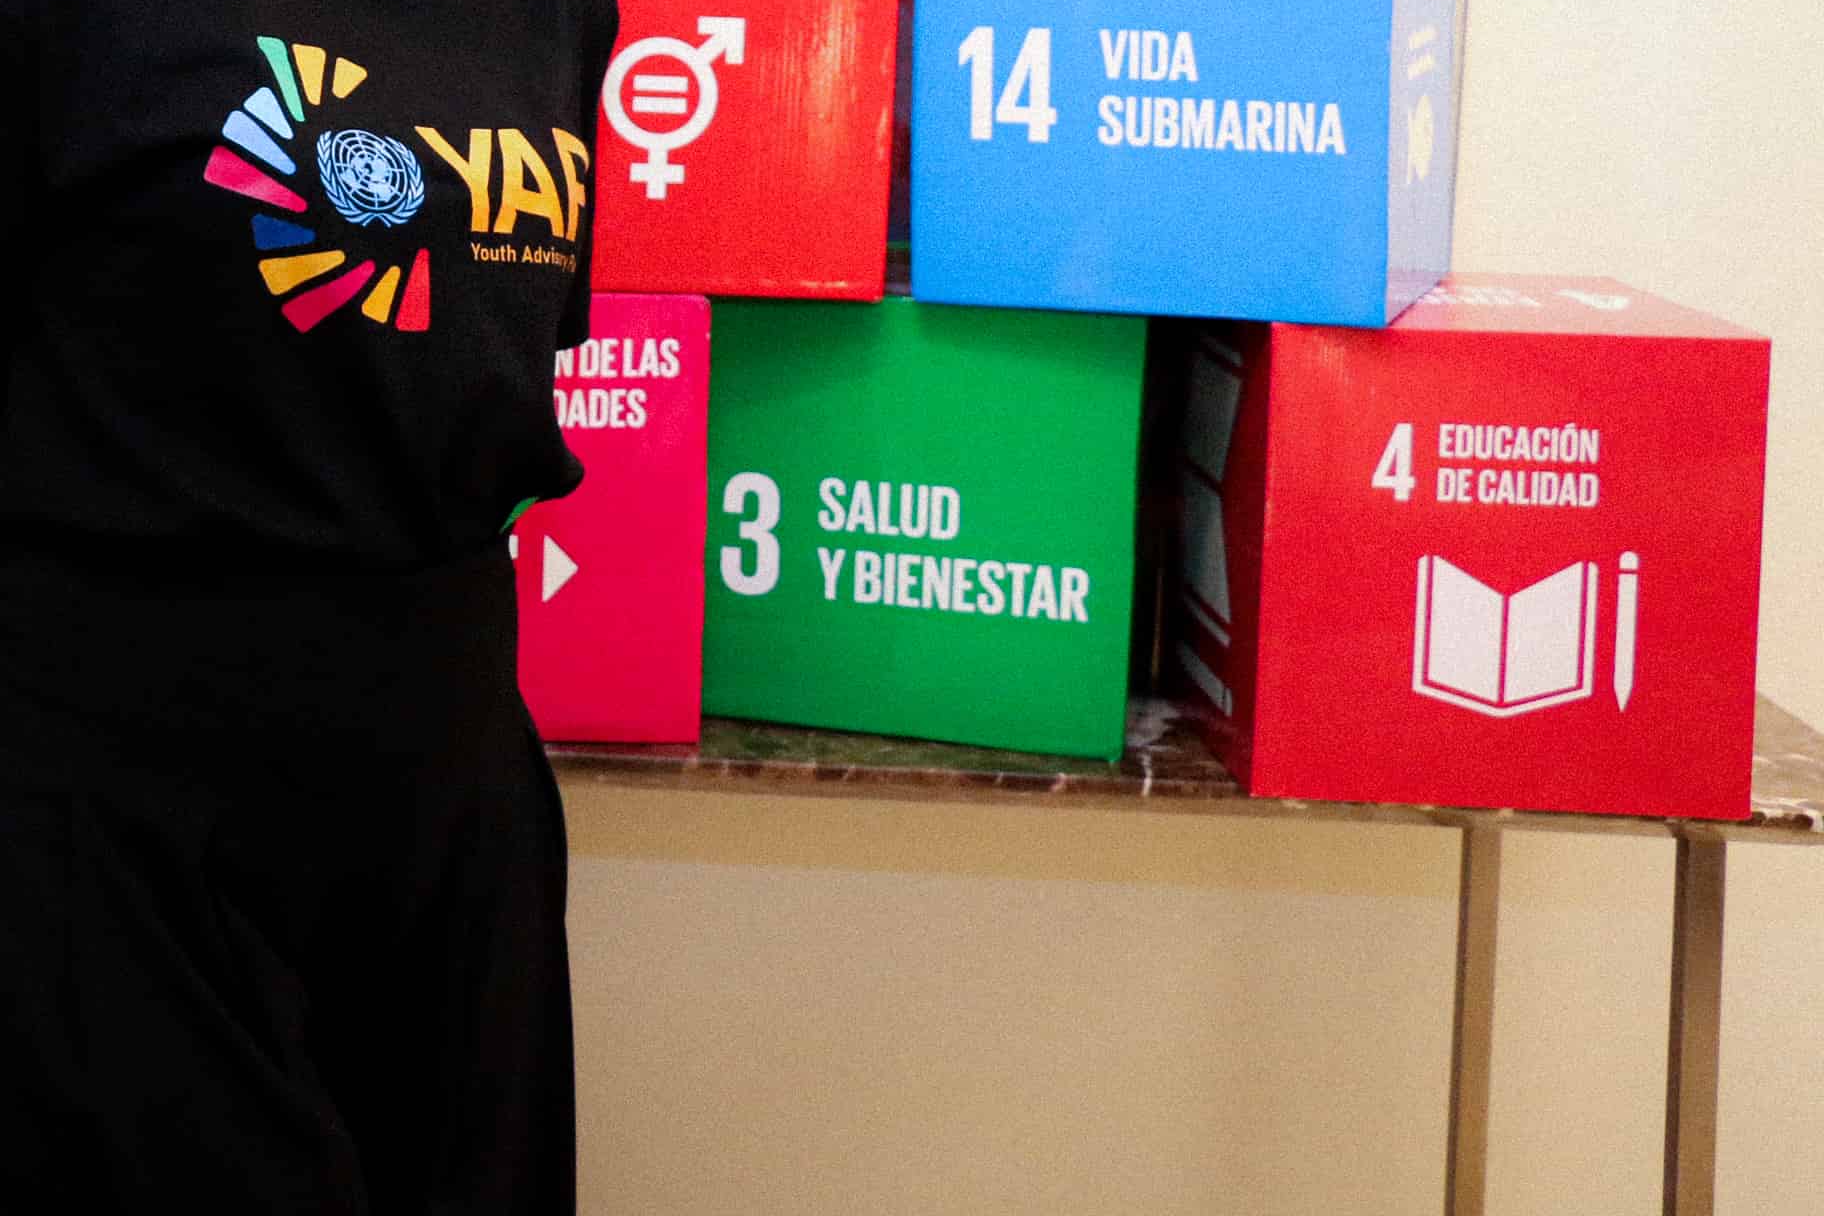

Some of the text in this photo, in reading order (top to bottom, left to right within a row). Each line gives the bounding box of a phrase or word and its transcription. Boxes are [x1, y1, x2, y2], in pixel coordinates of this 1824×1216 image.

[1098, 29, 1199, 82] VIDA
[958, 26, 1057, 144] 14
[1097, 94, 1347, 156] SUBMARINA
[471, 243, 517, 262] Youth
[579, 338, 619, 378] DE
[623, 338, 680, 378] LAS
[553, 388, 647, 429] DADES
[1371, 422, 1415, 501] 4
[1438, 421, 1600, 464] EDUCACIÓN
[817, 476, 960, 540] SALUD
[1436, 468, 1599, 508] DE CALIDAD
[720, 471, 780, 596] 3
[817, 547, 1089, 623] Y BIENESTAR
